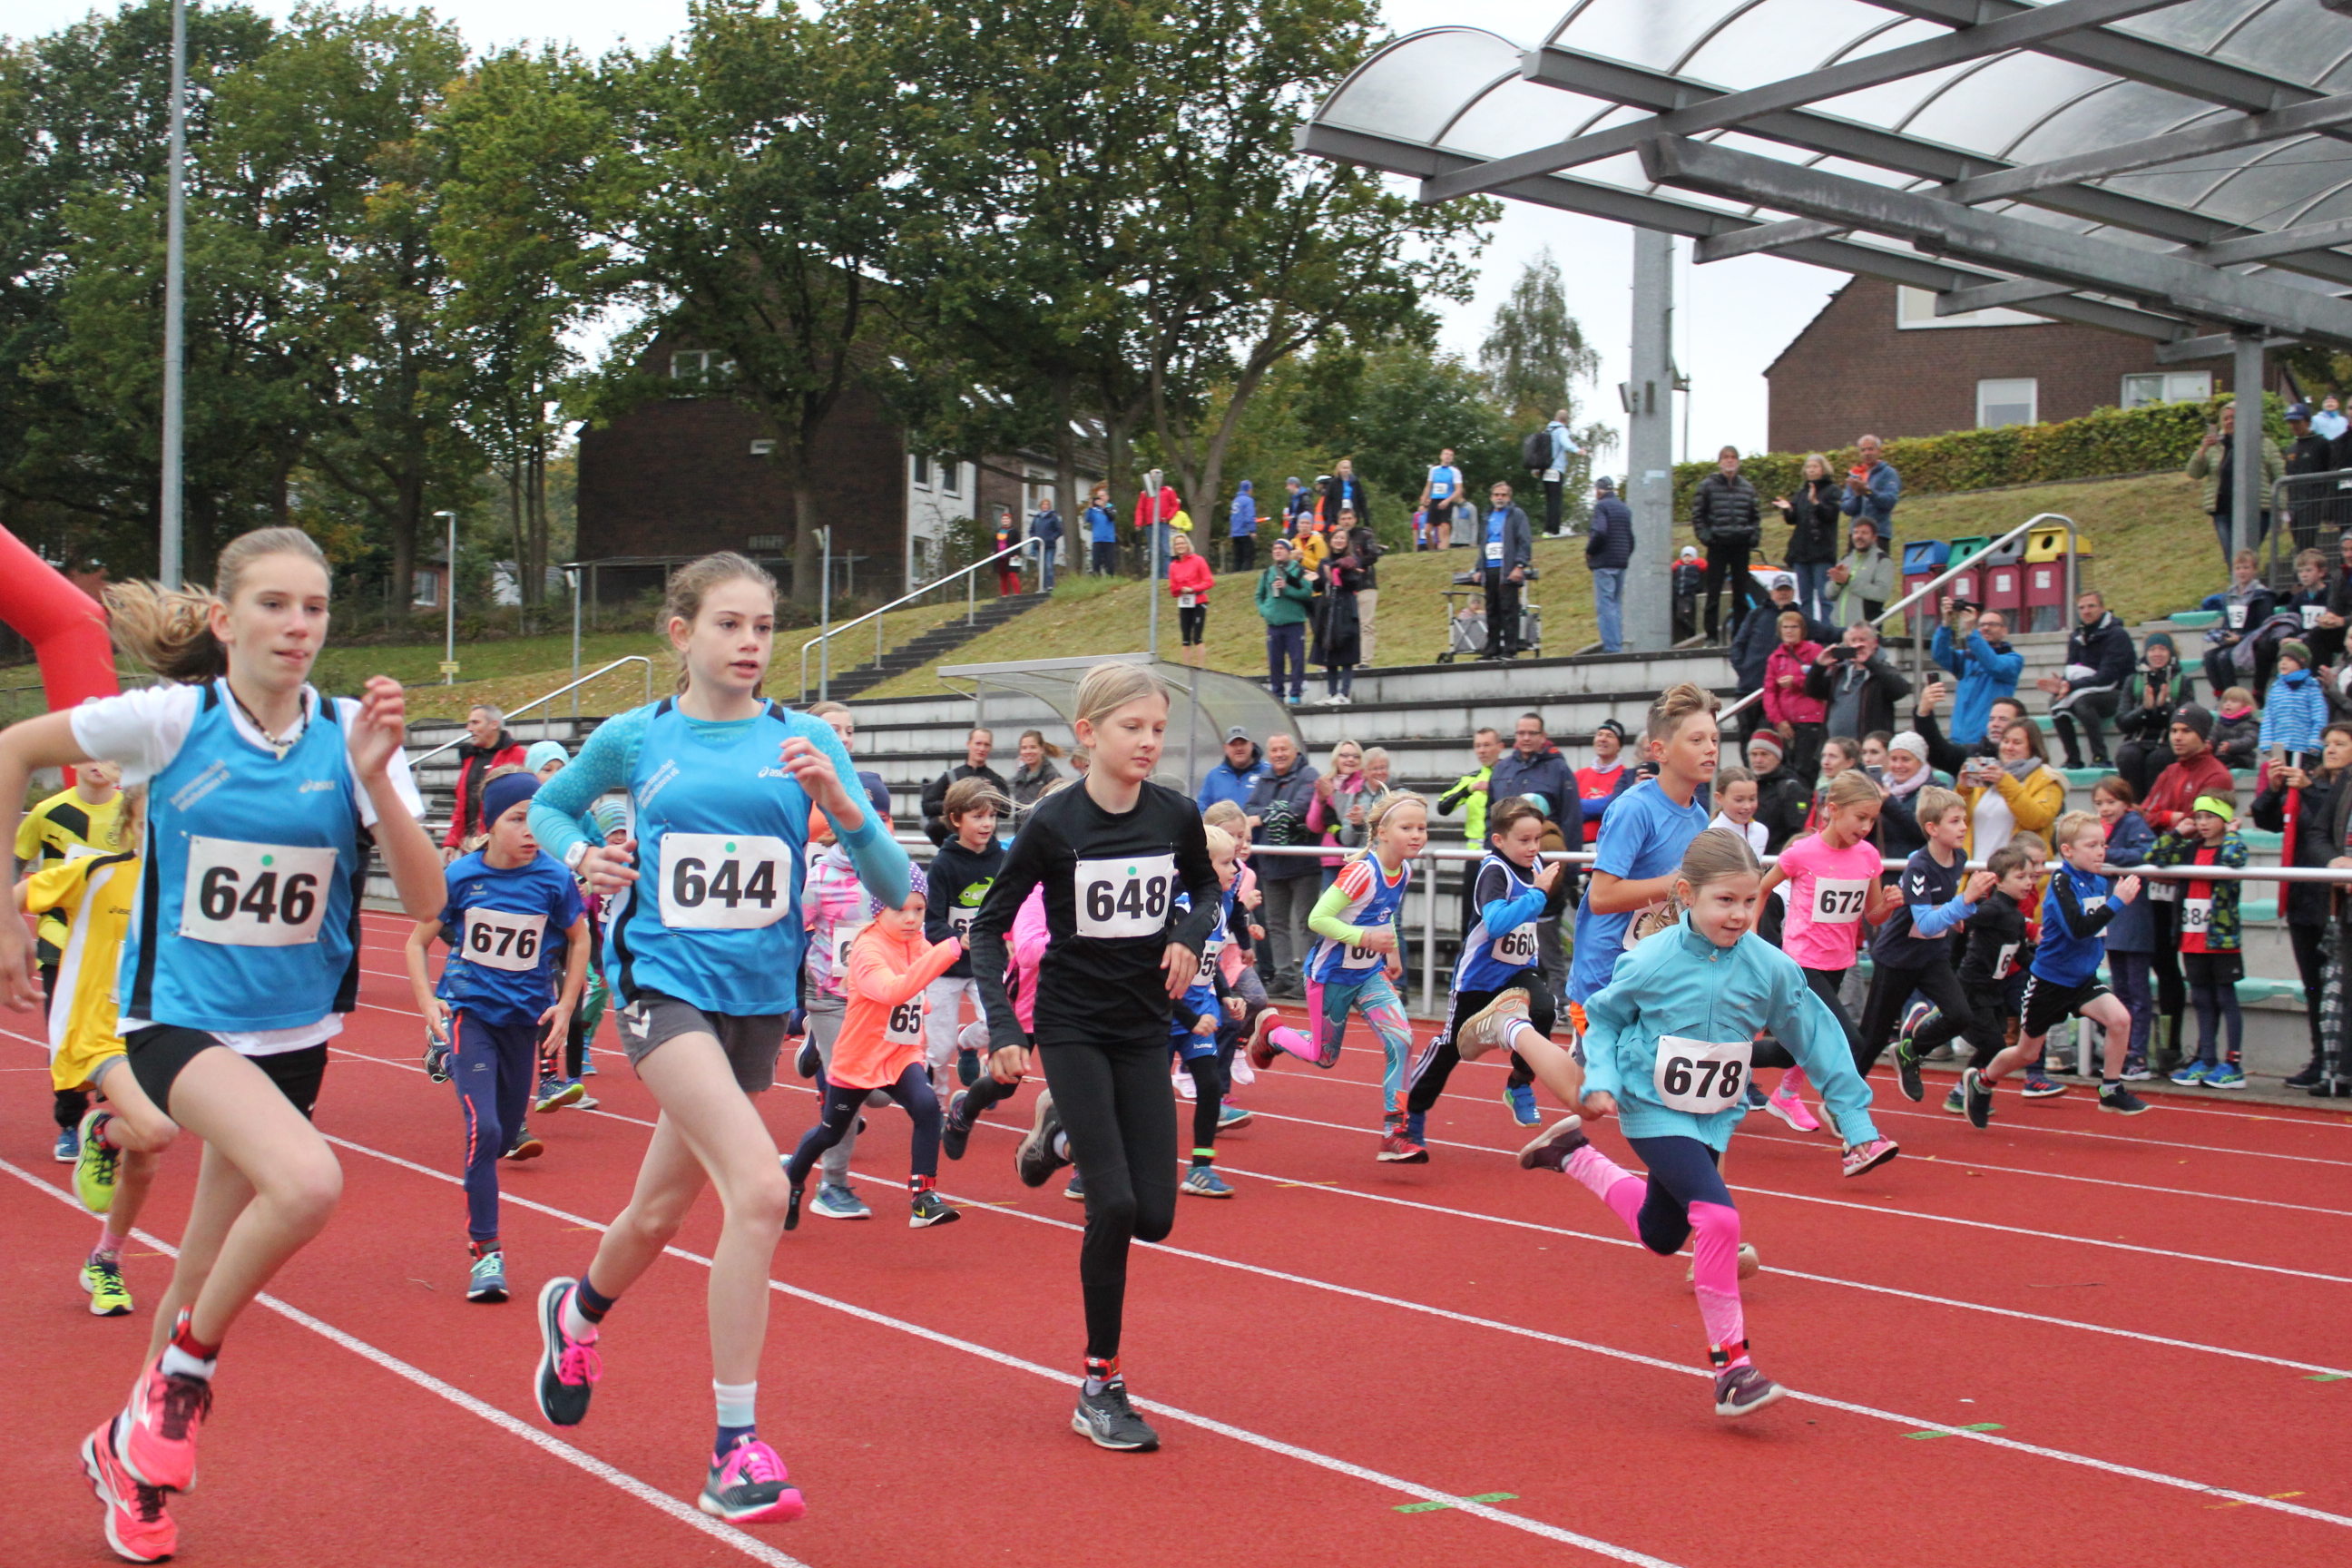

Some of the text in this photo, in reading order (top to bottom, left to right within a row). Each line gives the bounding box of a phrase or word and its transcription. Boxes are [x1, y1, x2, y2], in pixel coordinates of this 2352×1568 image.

[200, 866, 318, 926] 646
[672, 857, 777, 909] 644
[1086, 875, 1168, 922] 648
[1819, 889, 1866, 914] 672
[470, 922, 537, 959] 676
[1500, 932, 1536, 956] 660
[1663, 1055, 1743, 1099] 678
